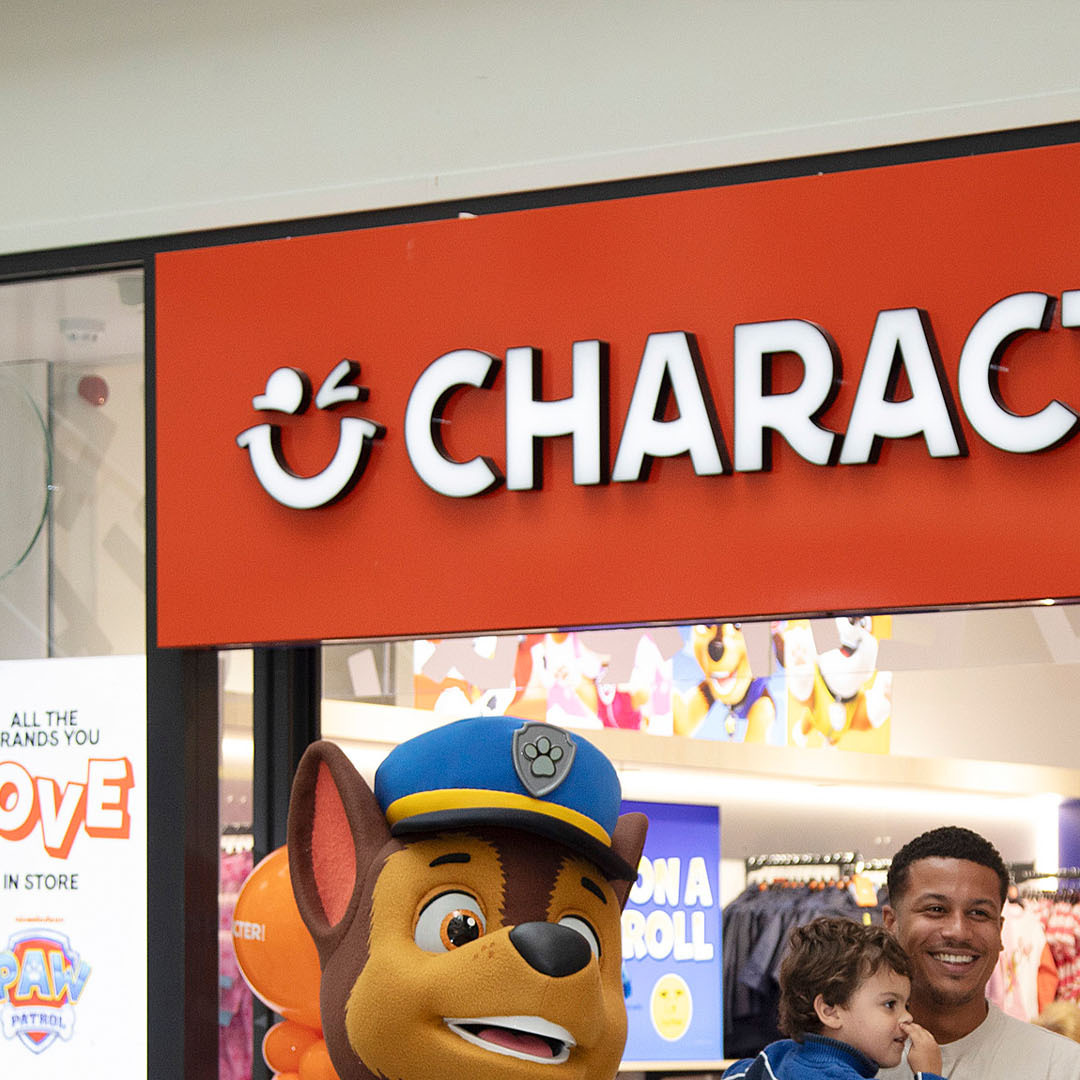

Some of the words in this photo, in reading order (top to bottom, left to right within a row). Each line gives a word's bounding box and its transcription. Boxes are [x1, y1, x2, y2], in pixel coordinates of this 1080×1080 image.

[10, 711, 40, 728] ALL
[46, 710, 78, 726] THE
[65, 729, 100, 746] YOU
[3, 874, 19, 890] IN
[25, 874, 79, 890] STORE
[629, 855, 681, 908] ON
[683, 856, 714, 907] A
[621, 909, 714, 962] ROLL
[11, 1013, 62, 1028] PATROL
